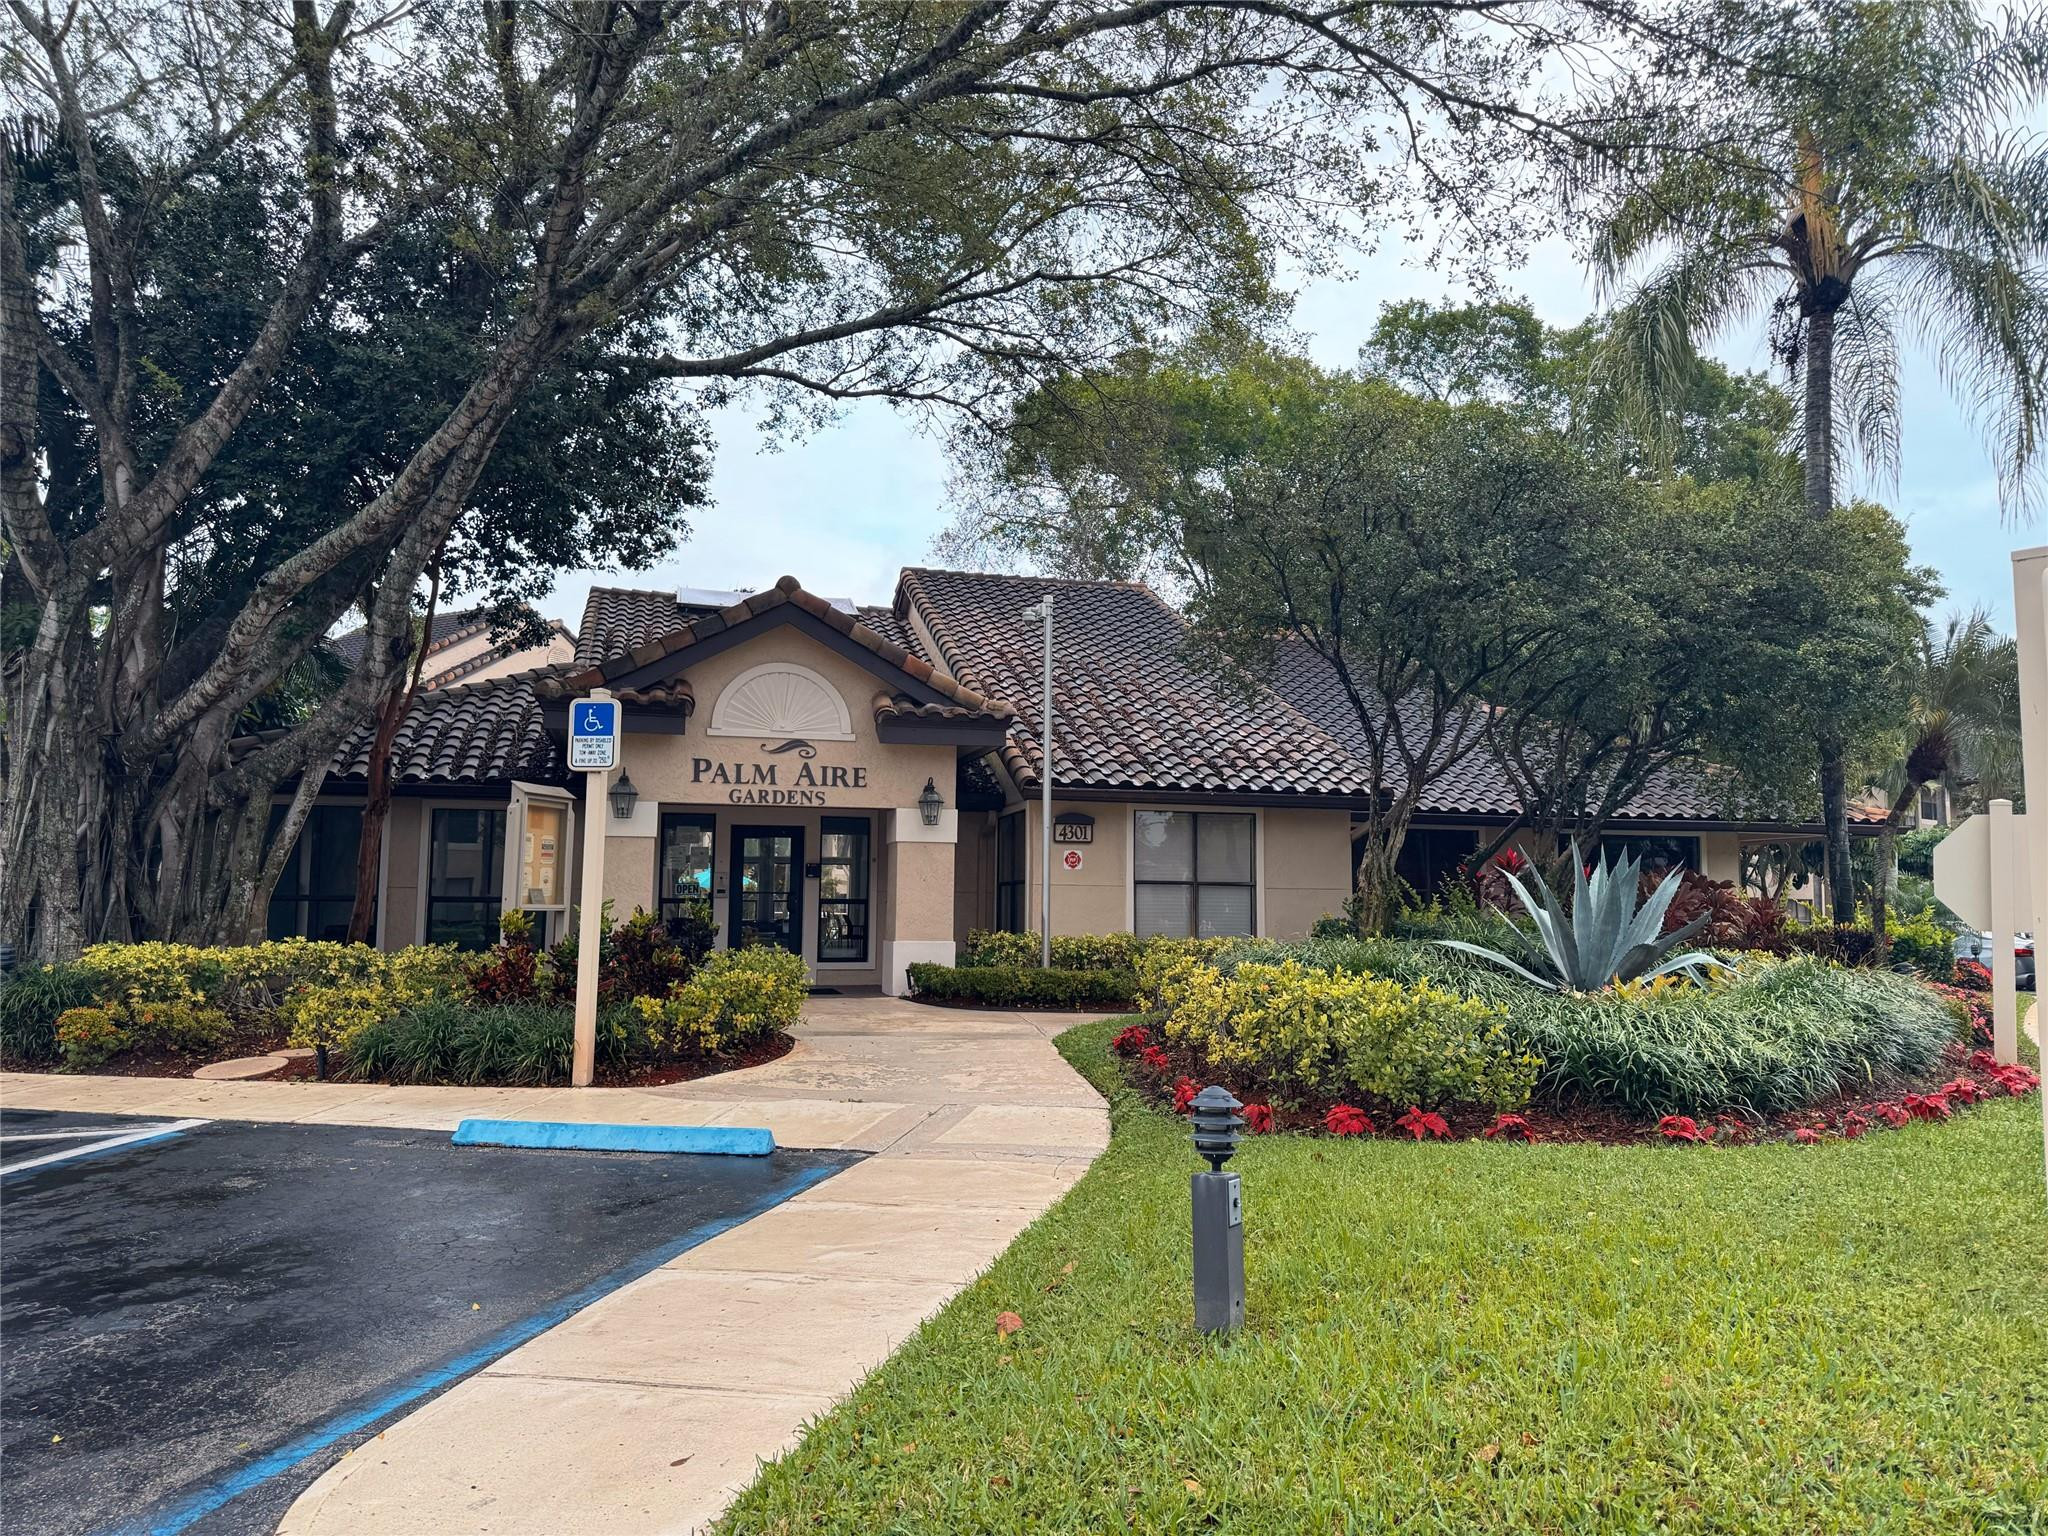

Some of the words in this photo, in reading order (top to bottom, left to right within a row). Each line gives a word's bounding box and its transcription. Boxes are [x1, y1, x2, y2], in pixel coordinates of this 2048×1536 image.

[690, 757, 778, 785] PALM
[793, 761, 868, 788] AIRE
[728, 788, 826, 806] GARDENS
[1059, 825, 1088, 840] 4301
[676, 884, 700, 894] OPEN
